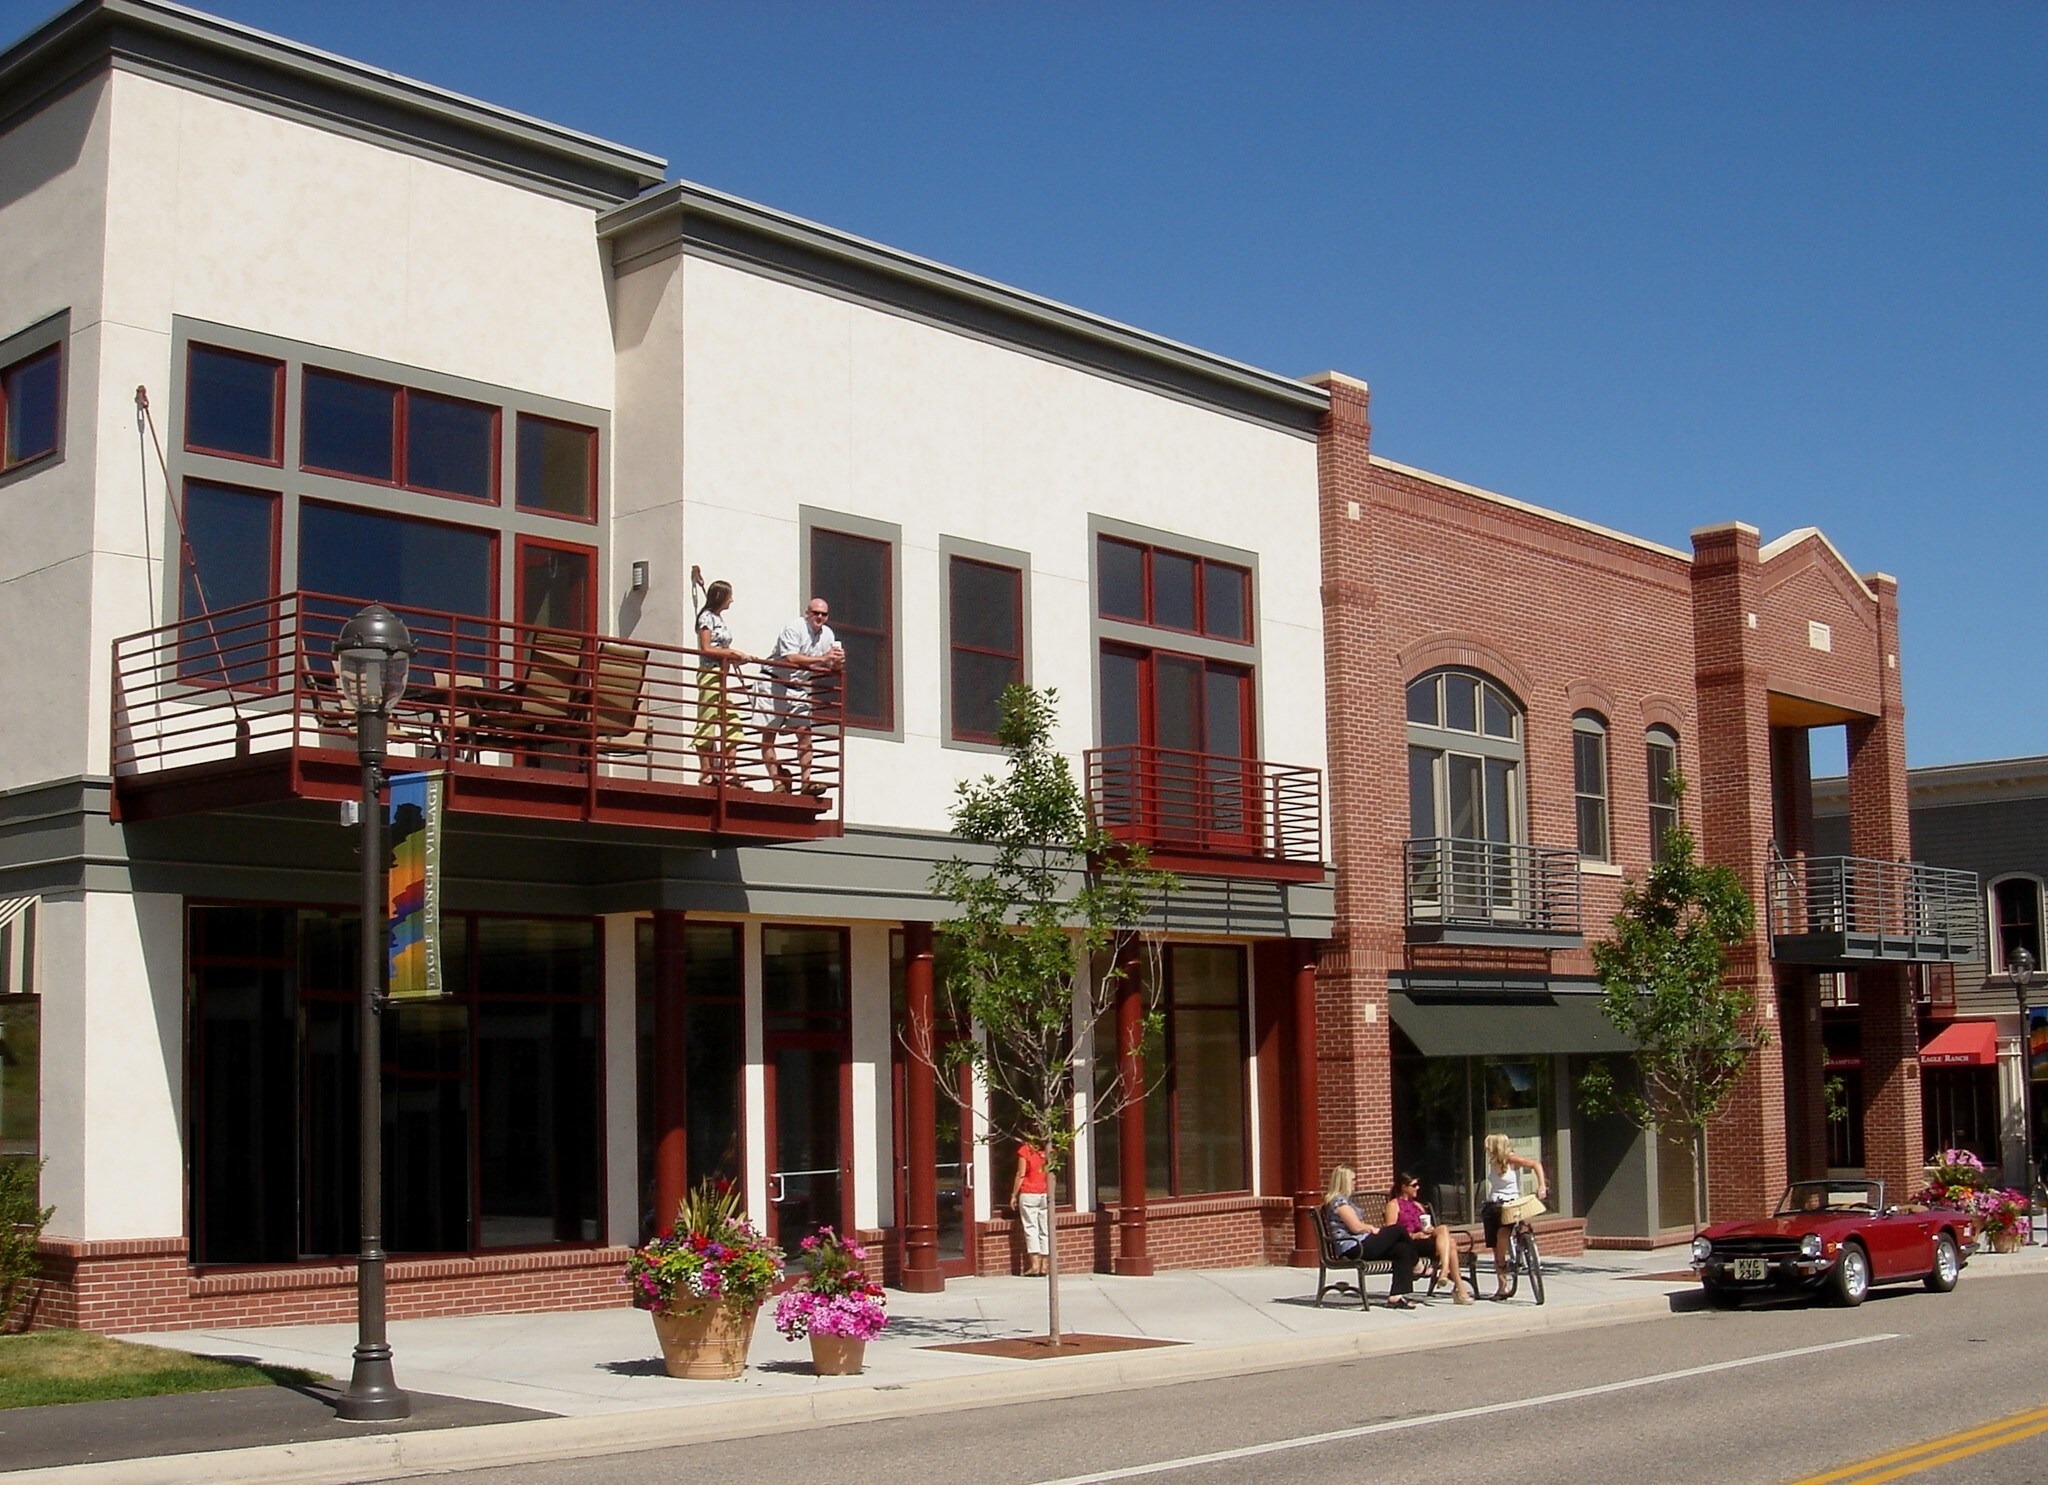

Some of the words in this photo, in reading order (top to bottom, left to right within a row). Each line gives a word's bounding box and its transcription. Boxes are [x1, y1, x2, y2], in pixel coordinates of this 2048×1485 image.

[426, 783, 438, 855] VILLAGE
[425, 864, 434, 923] RANCH
[425, 934, 436, 988] EAGLE
[1920, 1055, 1942, 1063] EAGLE
[1944, 1054, 1969, 1062] RANCH
